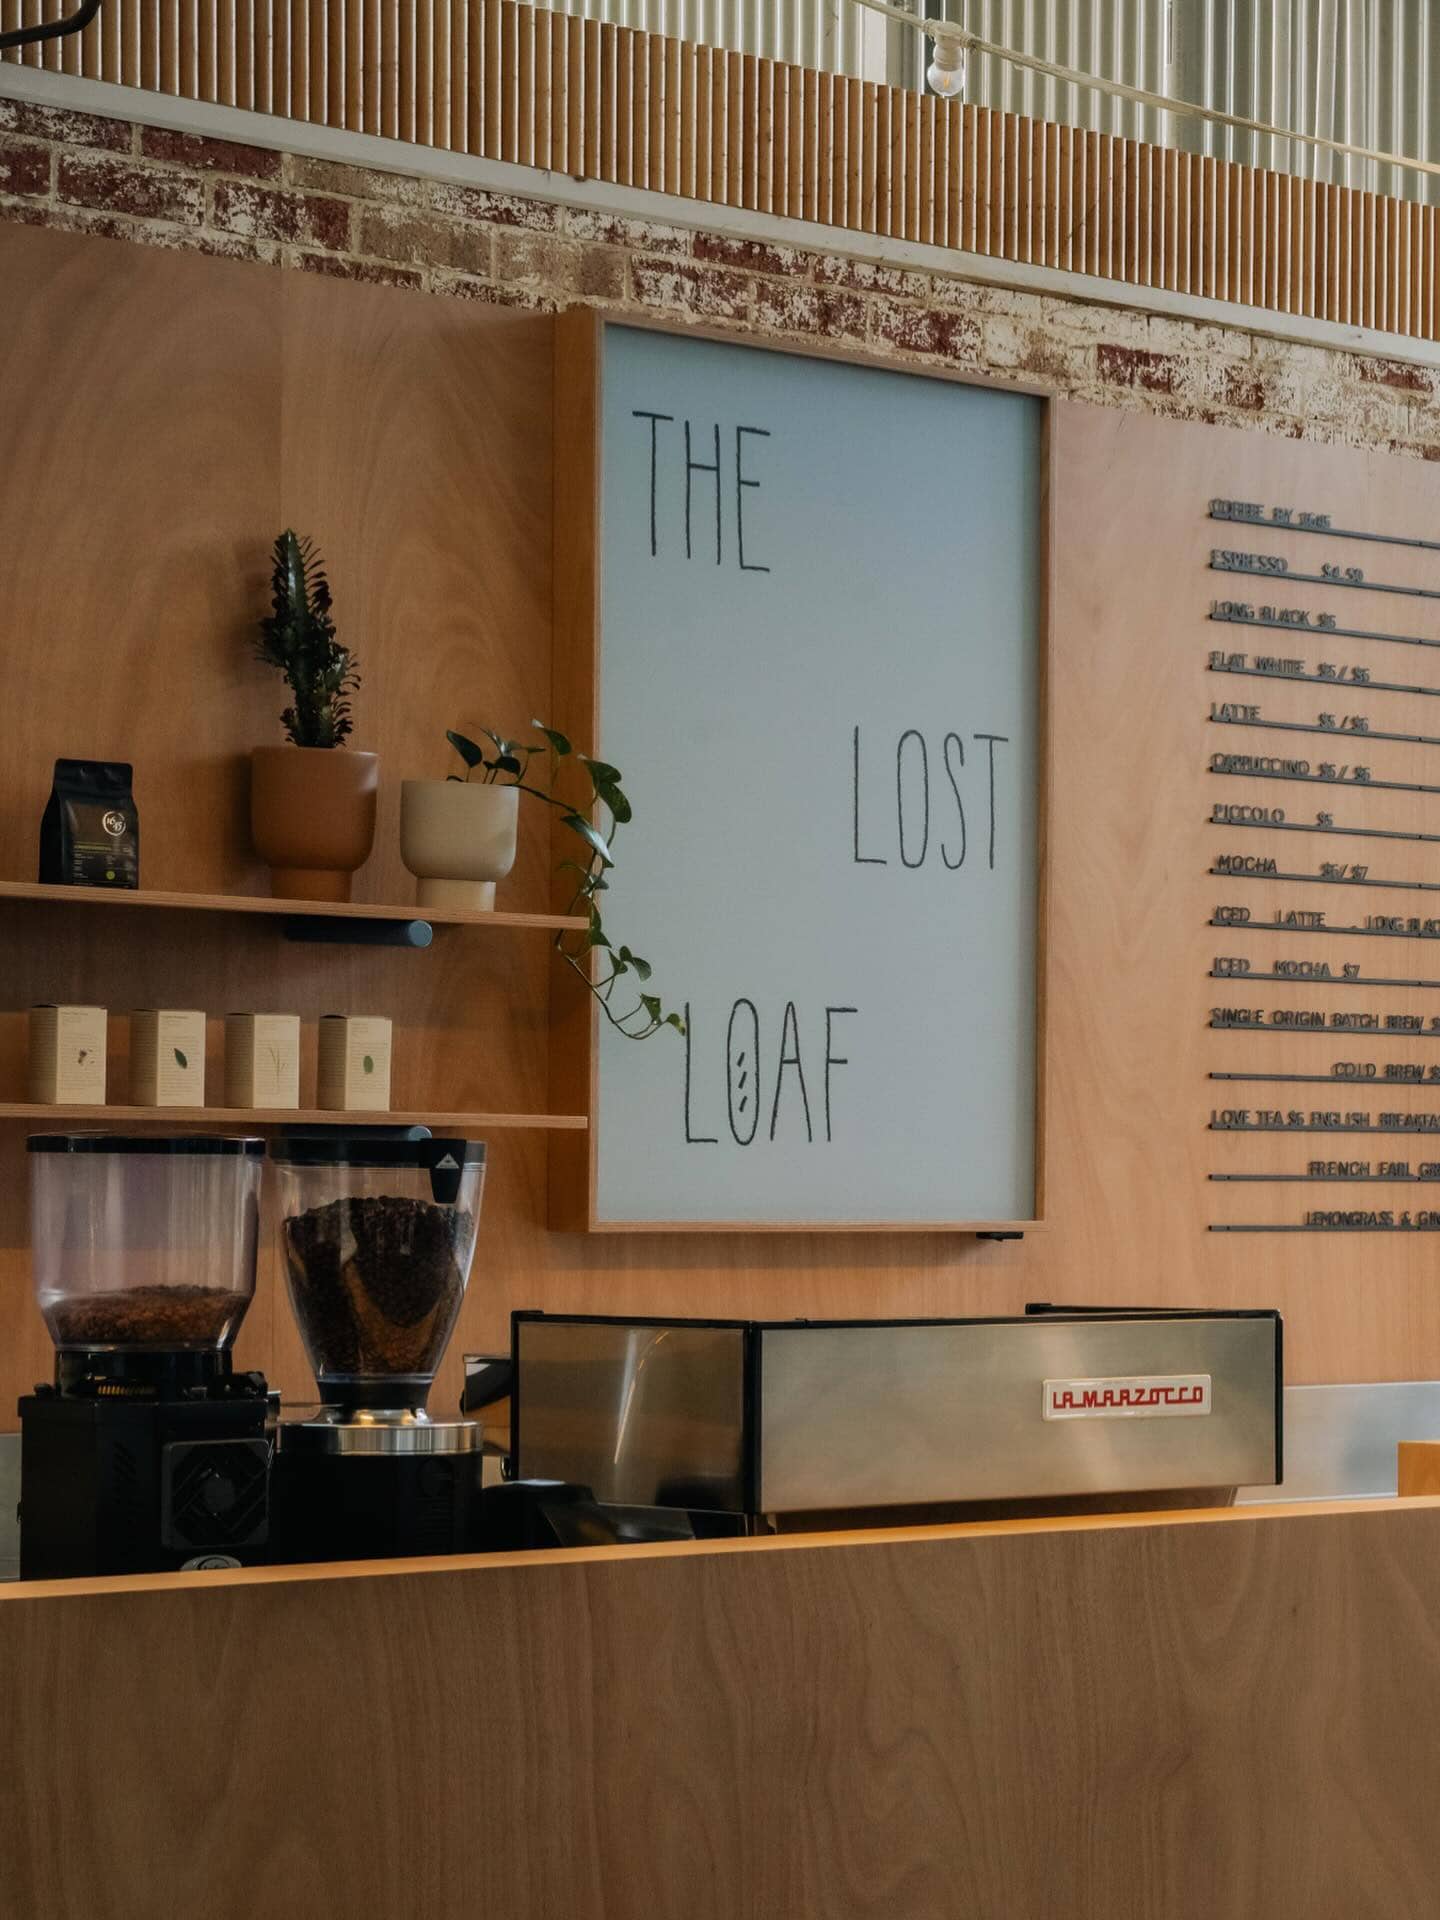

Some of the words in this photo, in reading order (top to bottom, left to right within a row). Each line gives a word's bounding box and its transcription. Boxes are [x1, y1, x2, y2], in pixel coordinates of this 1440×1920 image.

[632, 410, 770, 572] THE
[1210, 549, 1288, 572] ESPRESSO
[1210, 600, 1255, 619] LONG
[1259, 606, 1310, 626] BLACK
[1209, 651, 1248, 670] FLAT
[1254, 656, 1305, 675] WHITE
[1211, 702, 1261, 721] LATTE
[1211, 752, 1310, 776] CAPPUCCINO
[853, 725, 1008, 870] LOST
[1212, 803, 1285, 824] PICCOLO
[1217, 855, 1277, 874] MOCHA
[1214, 905, 1250, 922] ICED
[1274, 909, 1326, 928] LATTE
[1365, 915, 1404, 931] LONG
[1213, 957, 1250, 974] ICED
[1274, 960, 1331, 978] MOCHA
[1343, 962, 1360, 979] $7
[1210, 1008, 1264, 1025] SINGLE
[1273, 1010, 1325, 1027] ORIGIN
[1332, 1013, 1379, 1029] BATCH
[1386, 1015, 1424, 1031] BREW
[685, 998, 858, 1146] LOAF
[1332, 1062, 1376, 1078] COLD
[1385, 1064, 1425, 1080] BREW
[1211, 1109, 1250, 1125] LOVE
[1256, 1109, 1284, 1126] TEA
[1311, 1111, 1370, 1127] ENGLISH
[1308, 1161, 1370, 1177] FRENCH
[1379, 1162, 1414, 1177] EARL
[1306, 1211, 1394, 1226] LEMONGRASS
[1400, 1211, 1412, 1226] &
[1053, 1391, 1074, 1409] LA
